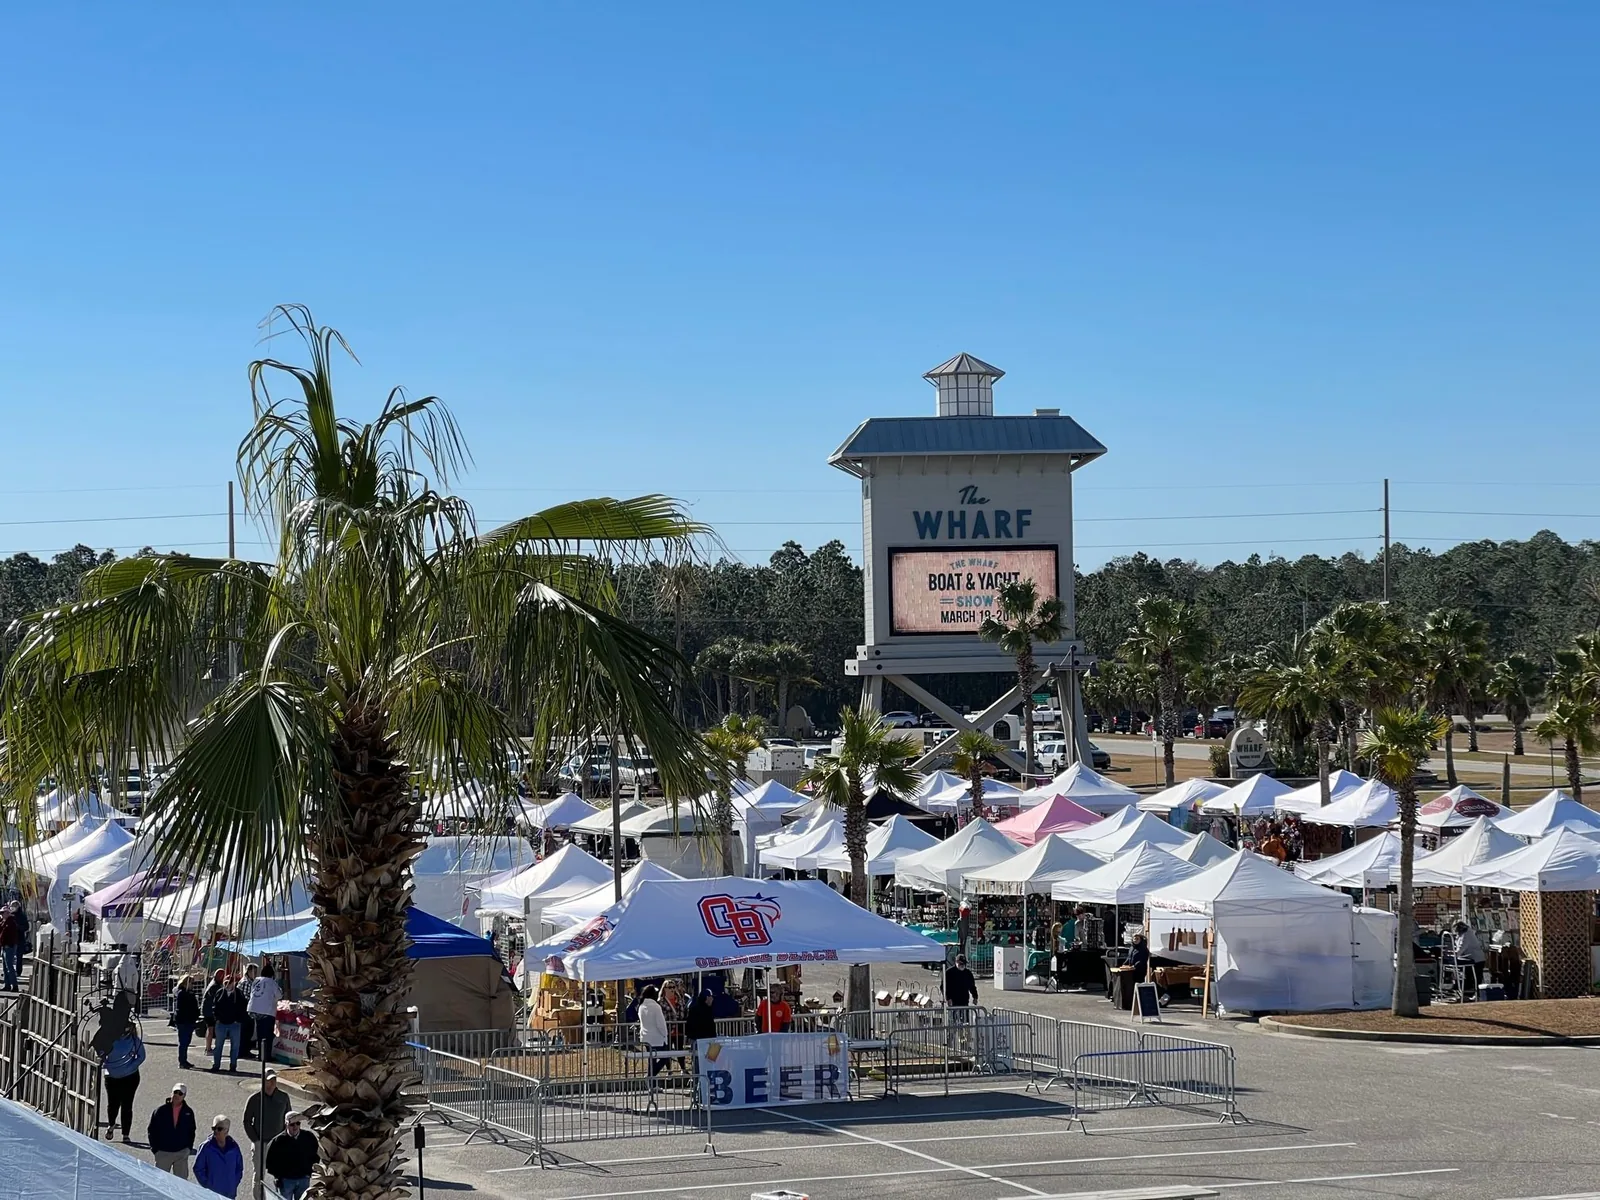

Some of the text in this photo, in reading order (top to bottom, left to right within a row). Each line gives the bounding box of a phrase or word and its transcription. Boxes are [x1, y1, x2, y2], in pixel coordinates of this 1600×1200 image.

[959, 485, 990, 504] The
[913, 510, 1032, 539] WHARF
[949, 558, 999, 571] THE WHARF
[928, 573, 963, 591] BOAT
[965, 572, 976, 590] &
[956, 595, 994, 608] SHOW
[941, 610, 975, 623] MARCH
[1236, 743, 1263, 752] WHARF
[697, 893, 772, 948] OB
[706, 1063, 842, 1105] BEER
